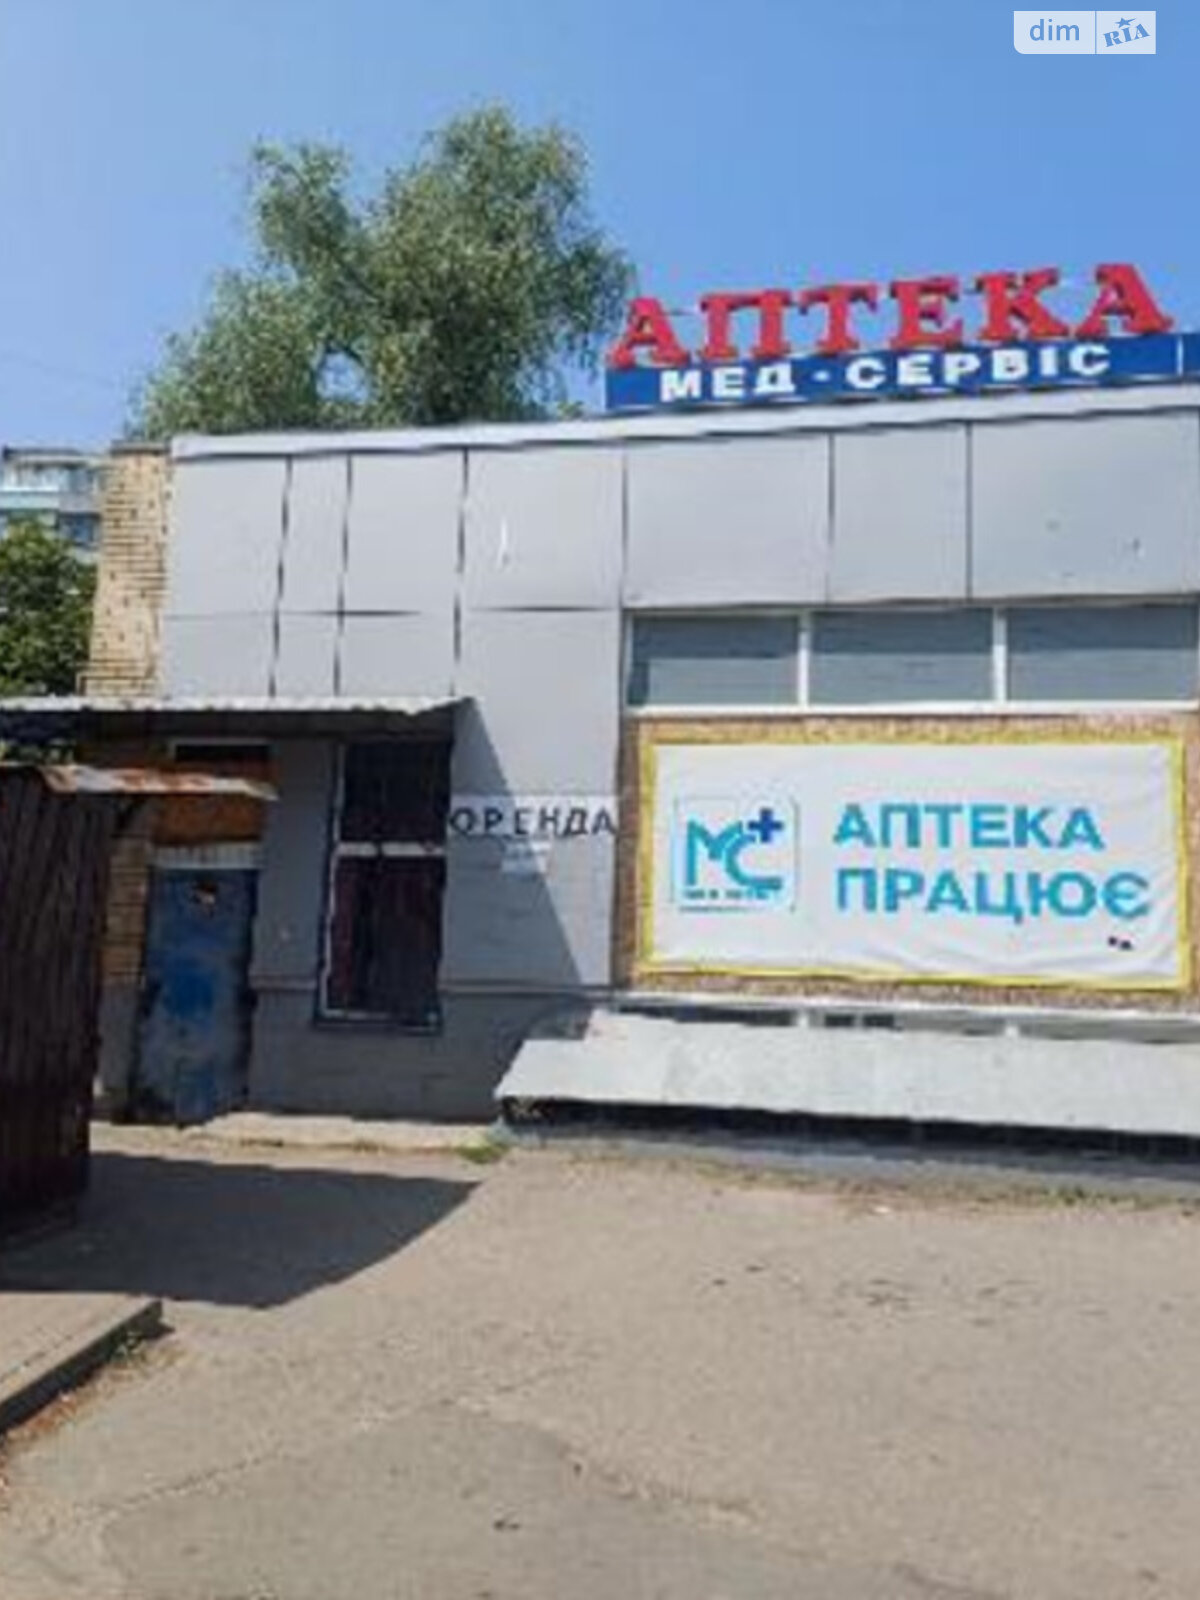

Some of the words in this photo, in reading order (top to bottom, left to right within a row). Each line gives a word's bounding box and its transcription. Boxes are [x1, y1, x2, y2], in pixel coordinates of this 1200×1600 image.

[609, 262, 1172, 367] АПТЕКА
[450, 807, 616, 836] ОРЕНДА
[833, 803, 1106, 850] АПТЕКА
[836, 867, 1151, 923] ПРАЦЮЄ
